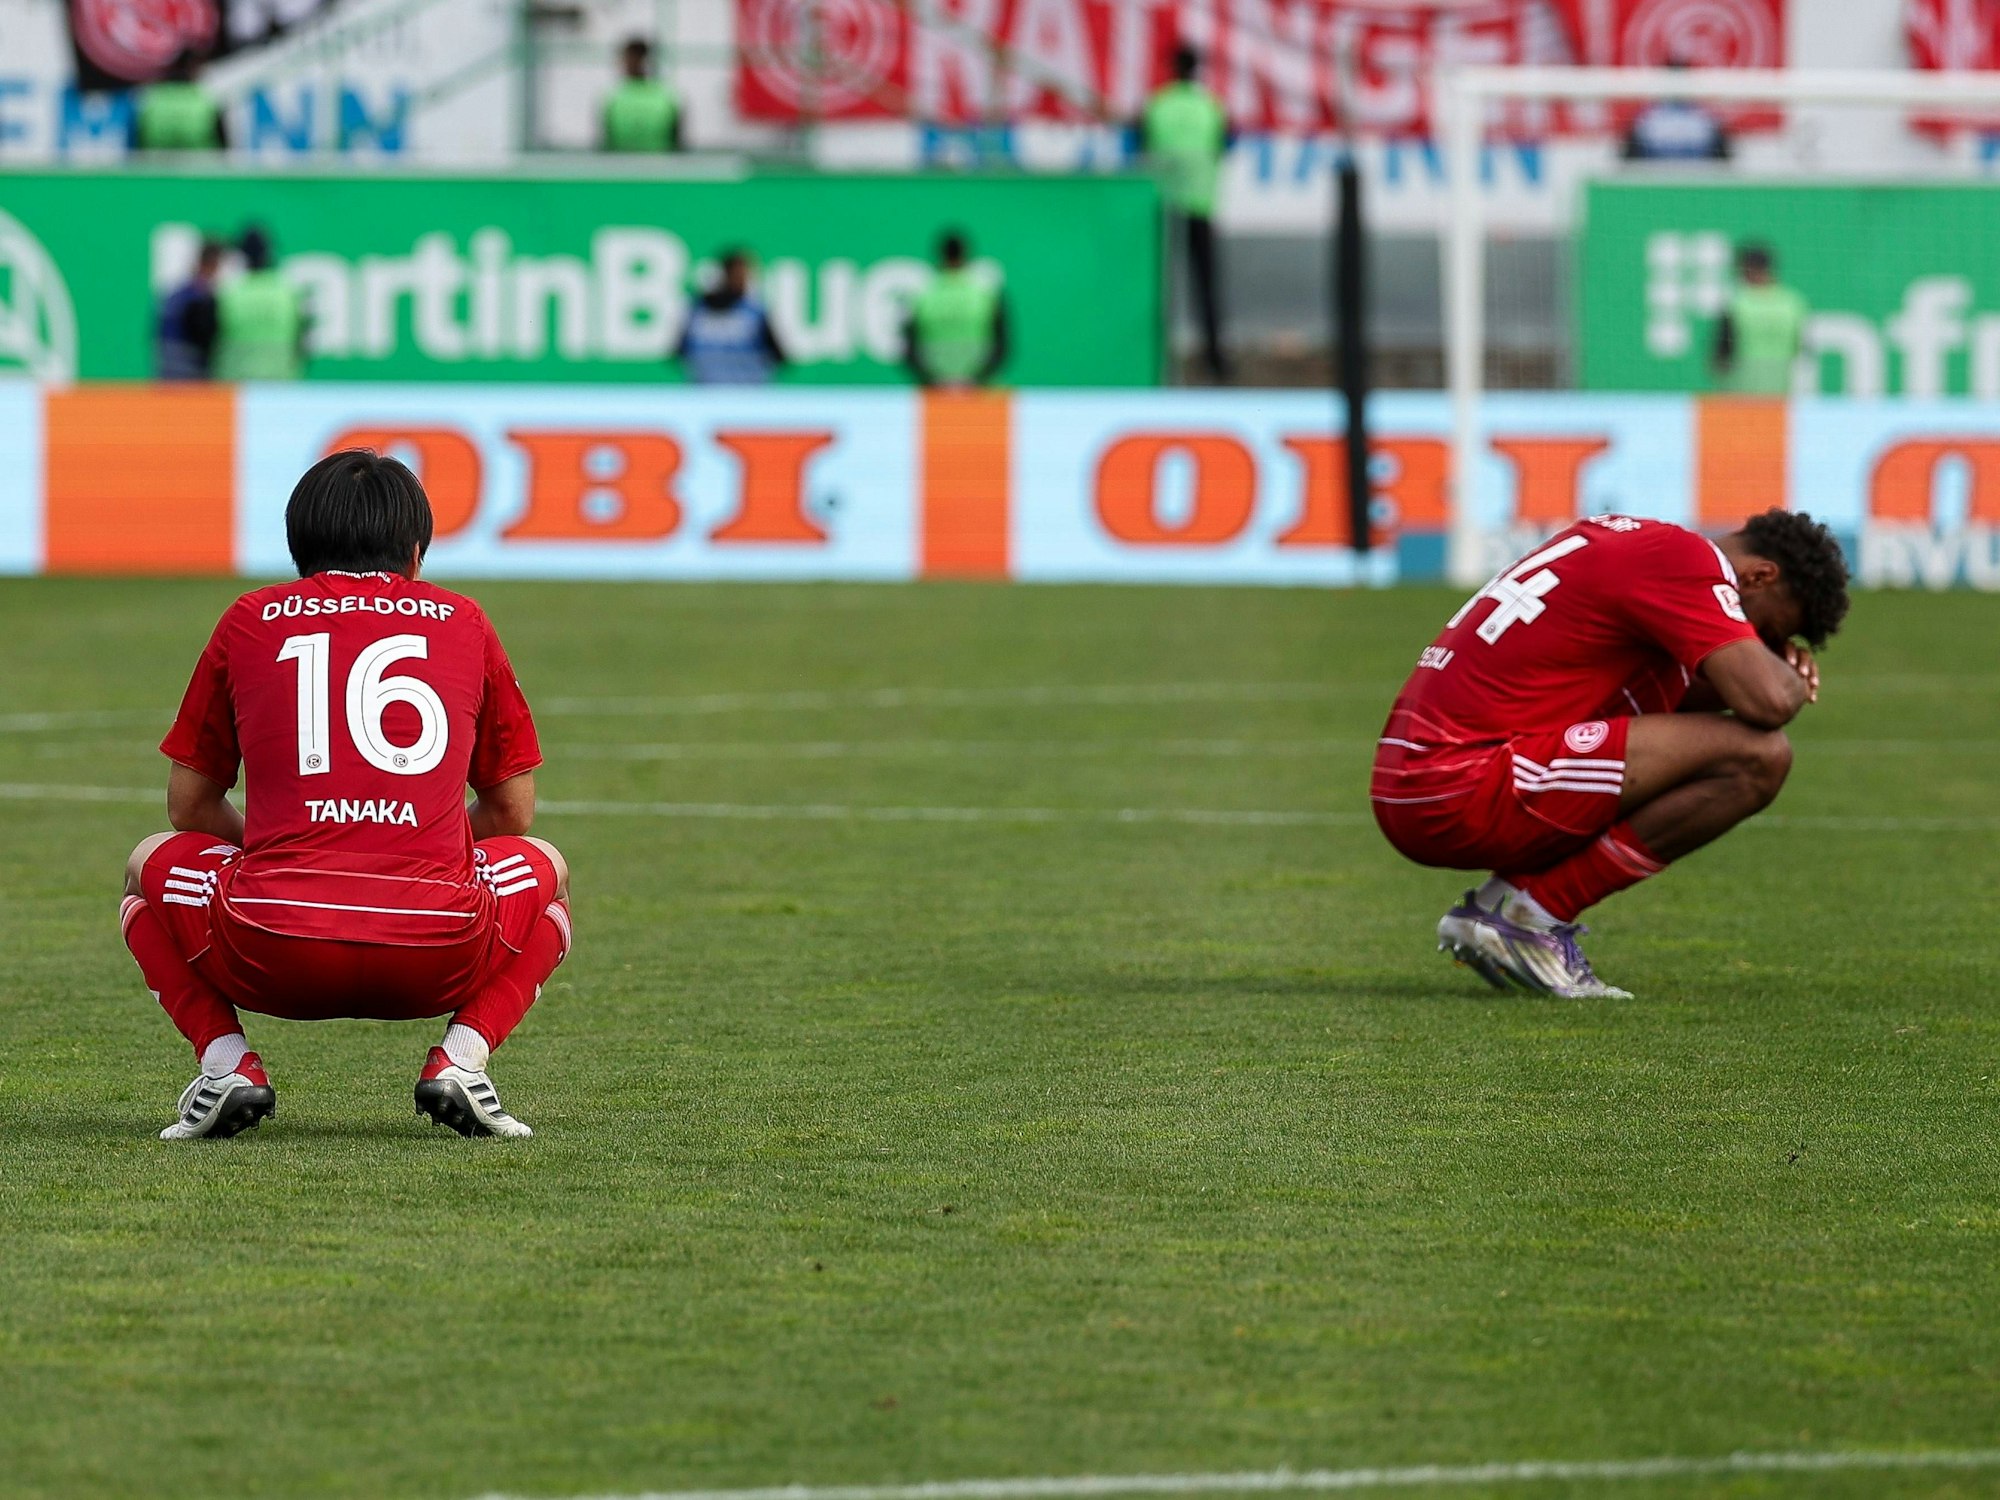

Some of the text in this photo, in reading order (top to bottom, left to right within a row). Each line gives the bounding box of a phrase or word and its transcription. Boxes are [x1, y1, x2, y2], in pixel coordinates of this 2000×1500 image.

[261, 595, 455, 622] DÜSSELDORF
[1446, 534, 1590, 646] 4
[275, 632, 449, 776] 16
[304, 798, 418, 828] TANAKA
